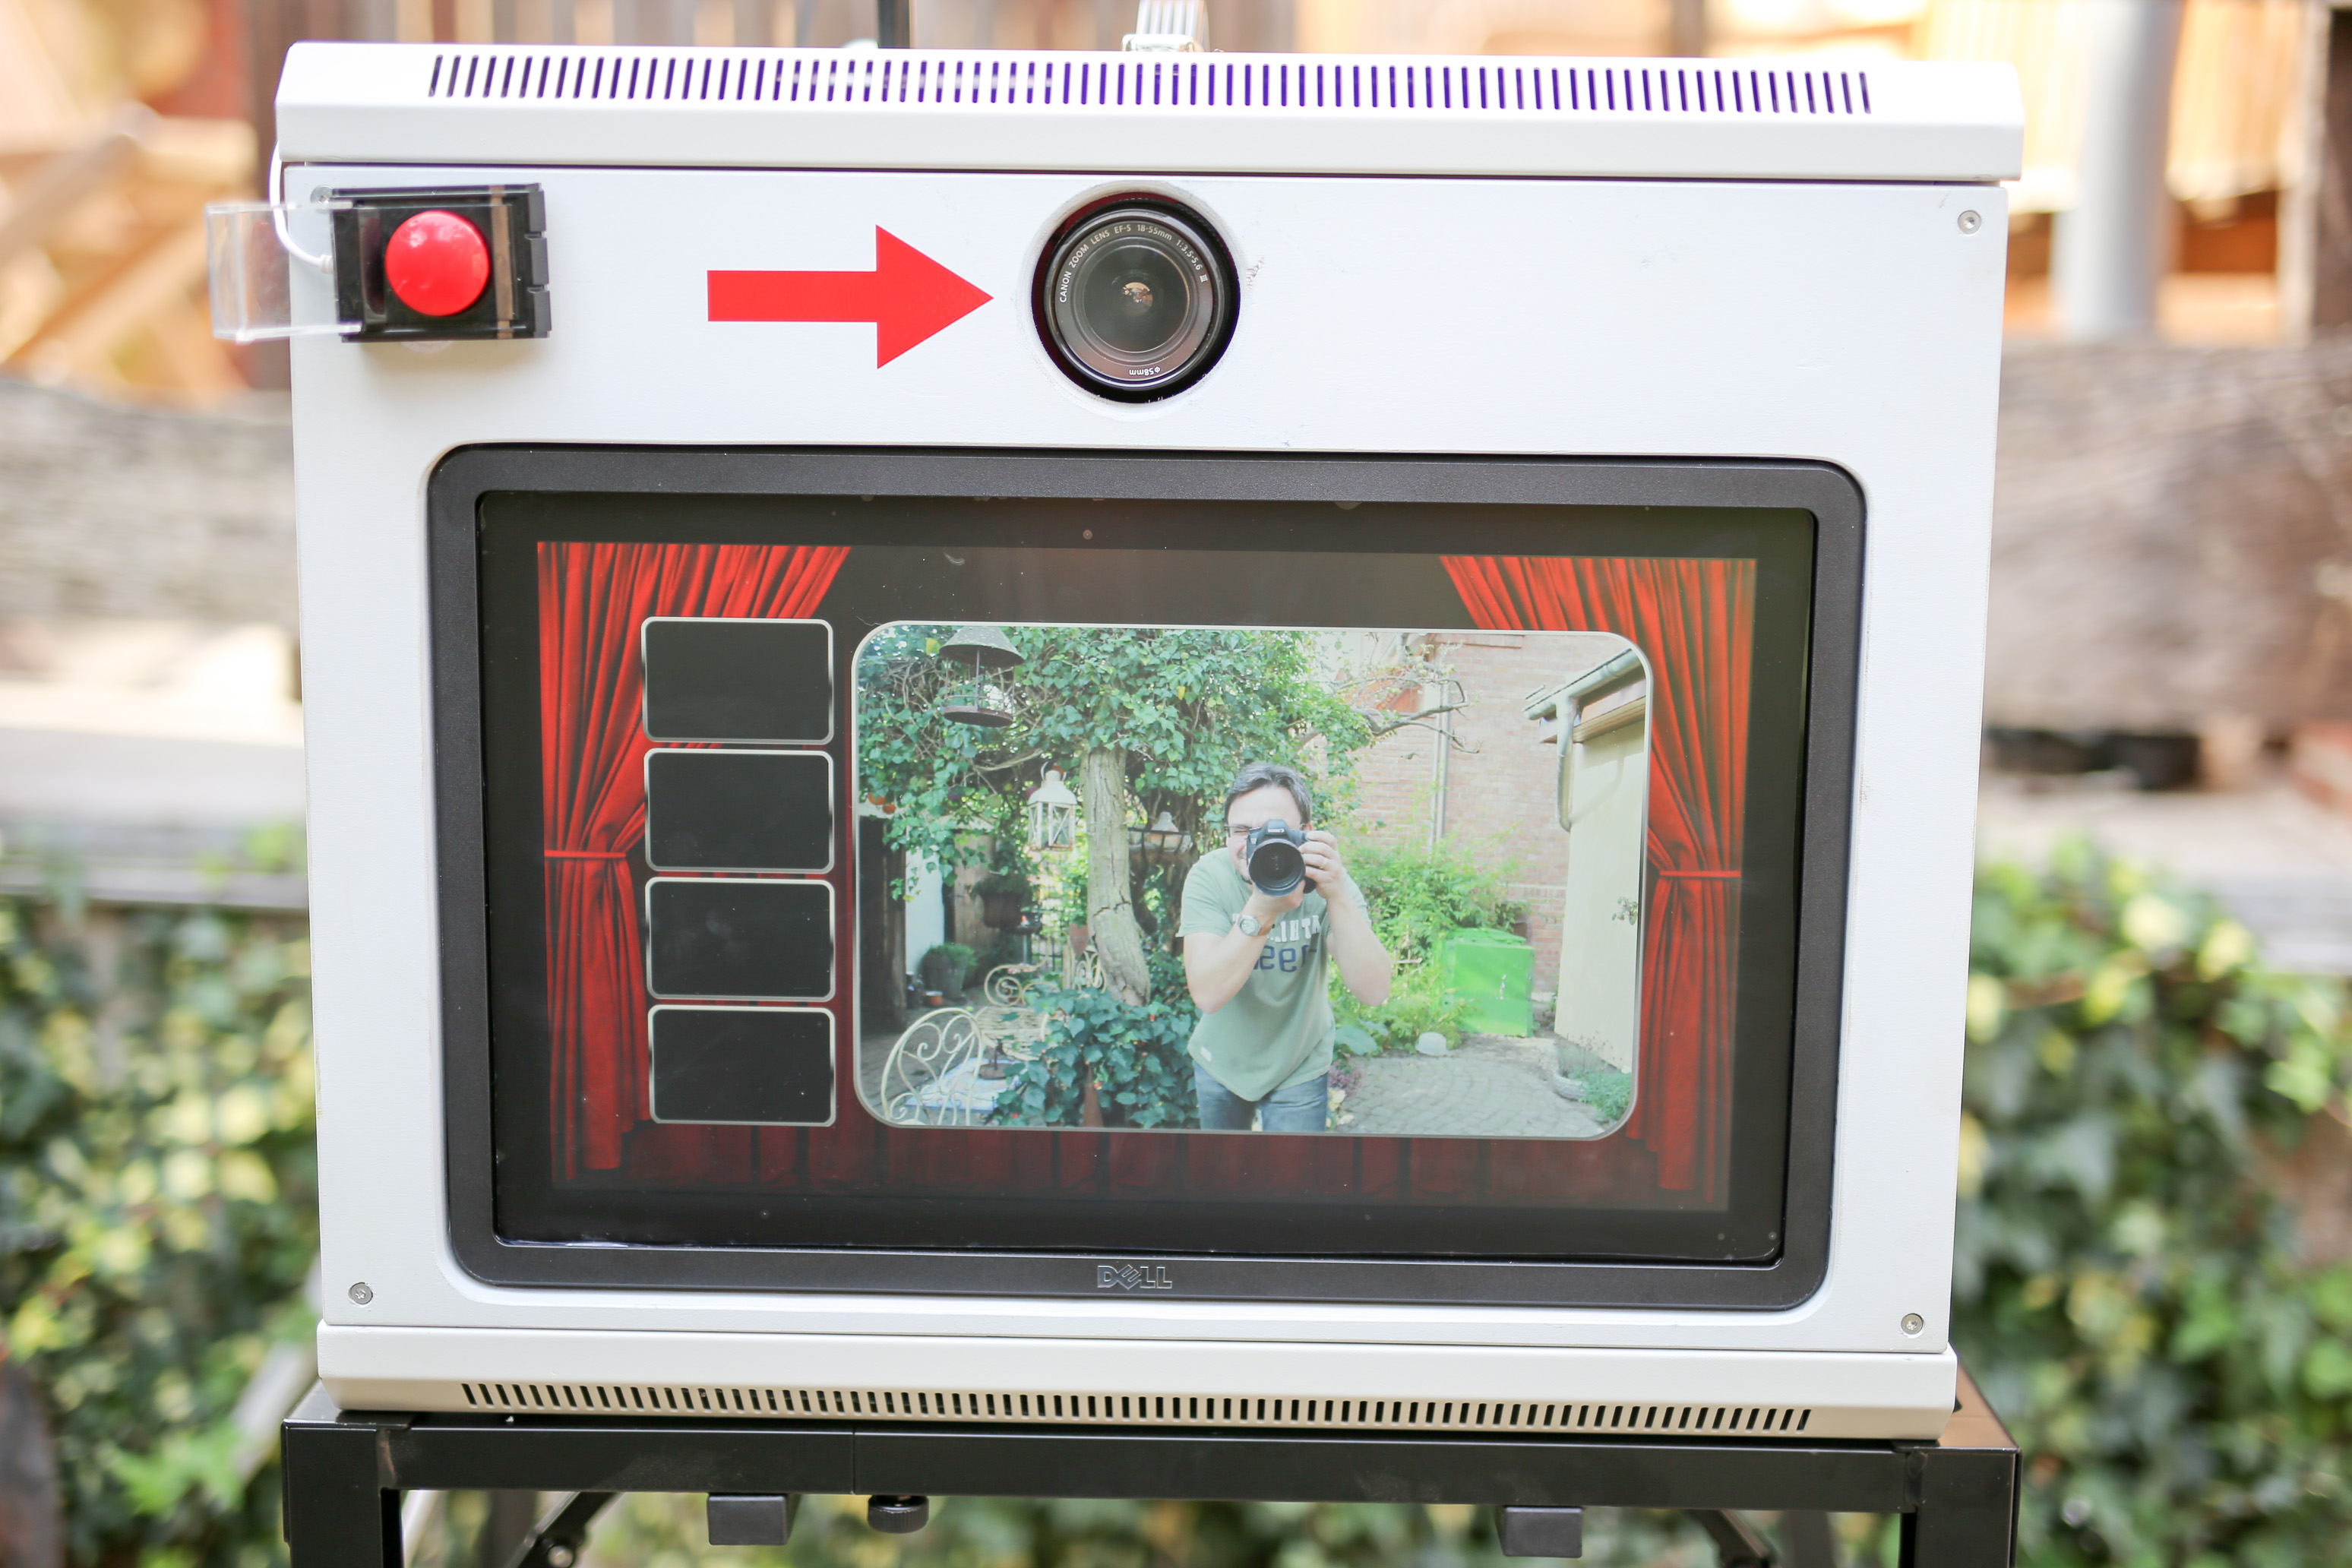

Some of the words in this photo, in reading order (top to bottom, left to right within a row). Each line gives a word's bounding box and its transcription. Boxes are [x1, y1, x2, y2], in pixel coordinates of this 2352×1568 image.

[1060, 271, 1072, 303] CANON
[1068, 244, 1089, 268] ZOOM
[1090, 229, 1110, 245] LENS
[1114, 224, 1131, 234] EF-S
[1137, 224, 1172, 241] 18-55mm
[1176, 239, 1203, 270] 1:3.5-5.6
[1097, 1264, 1173, 1290] DELL
